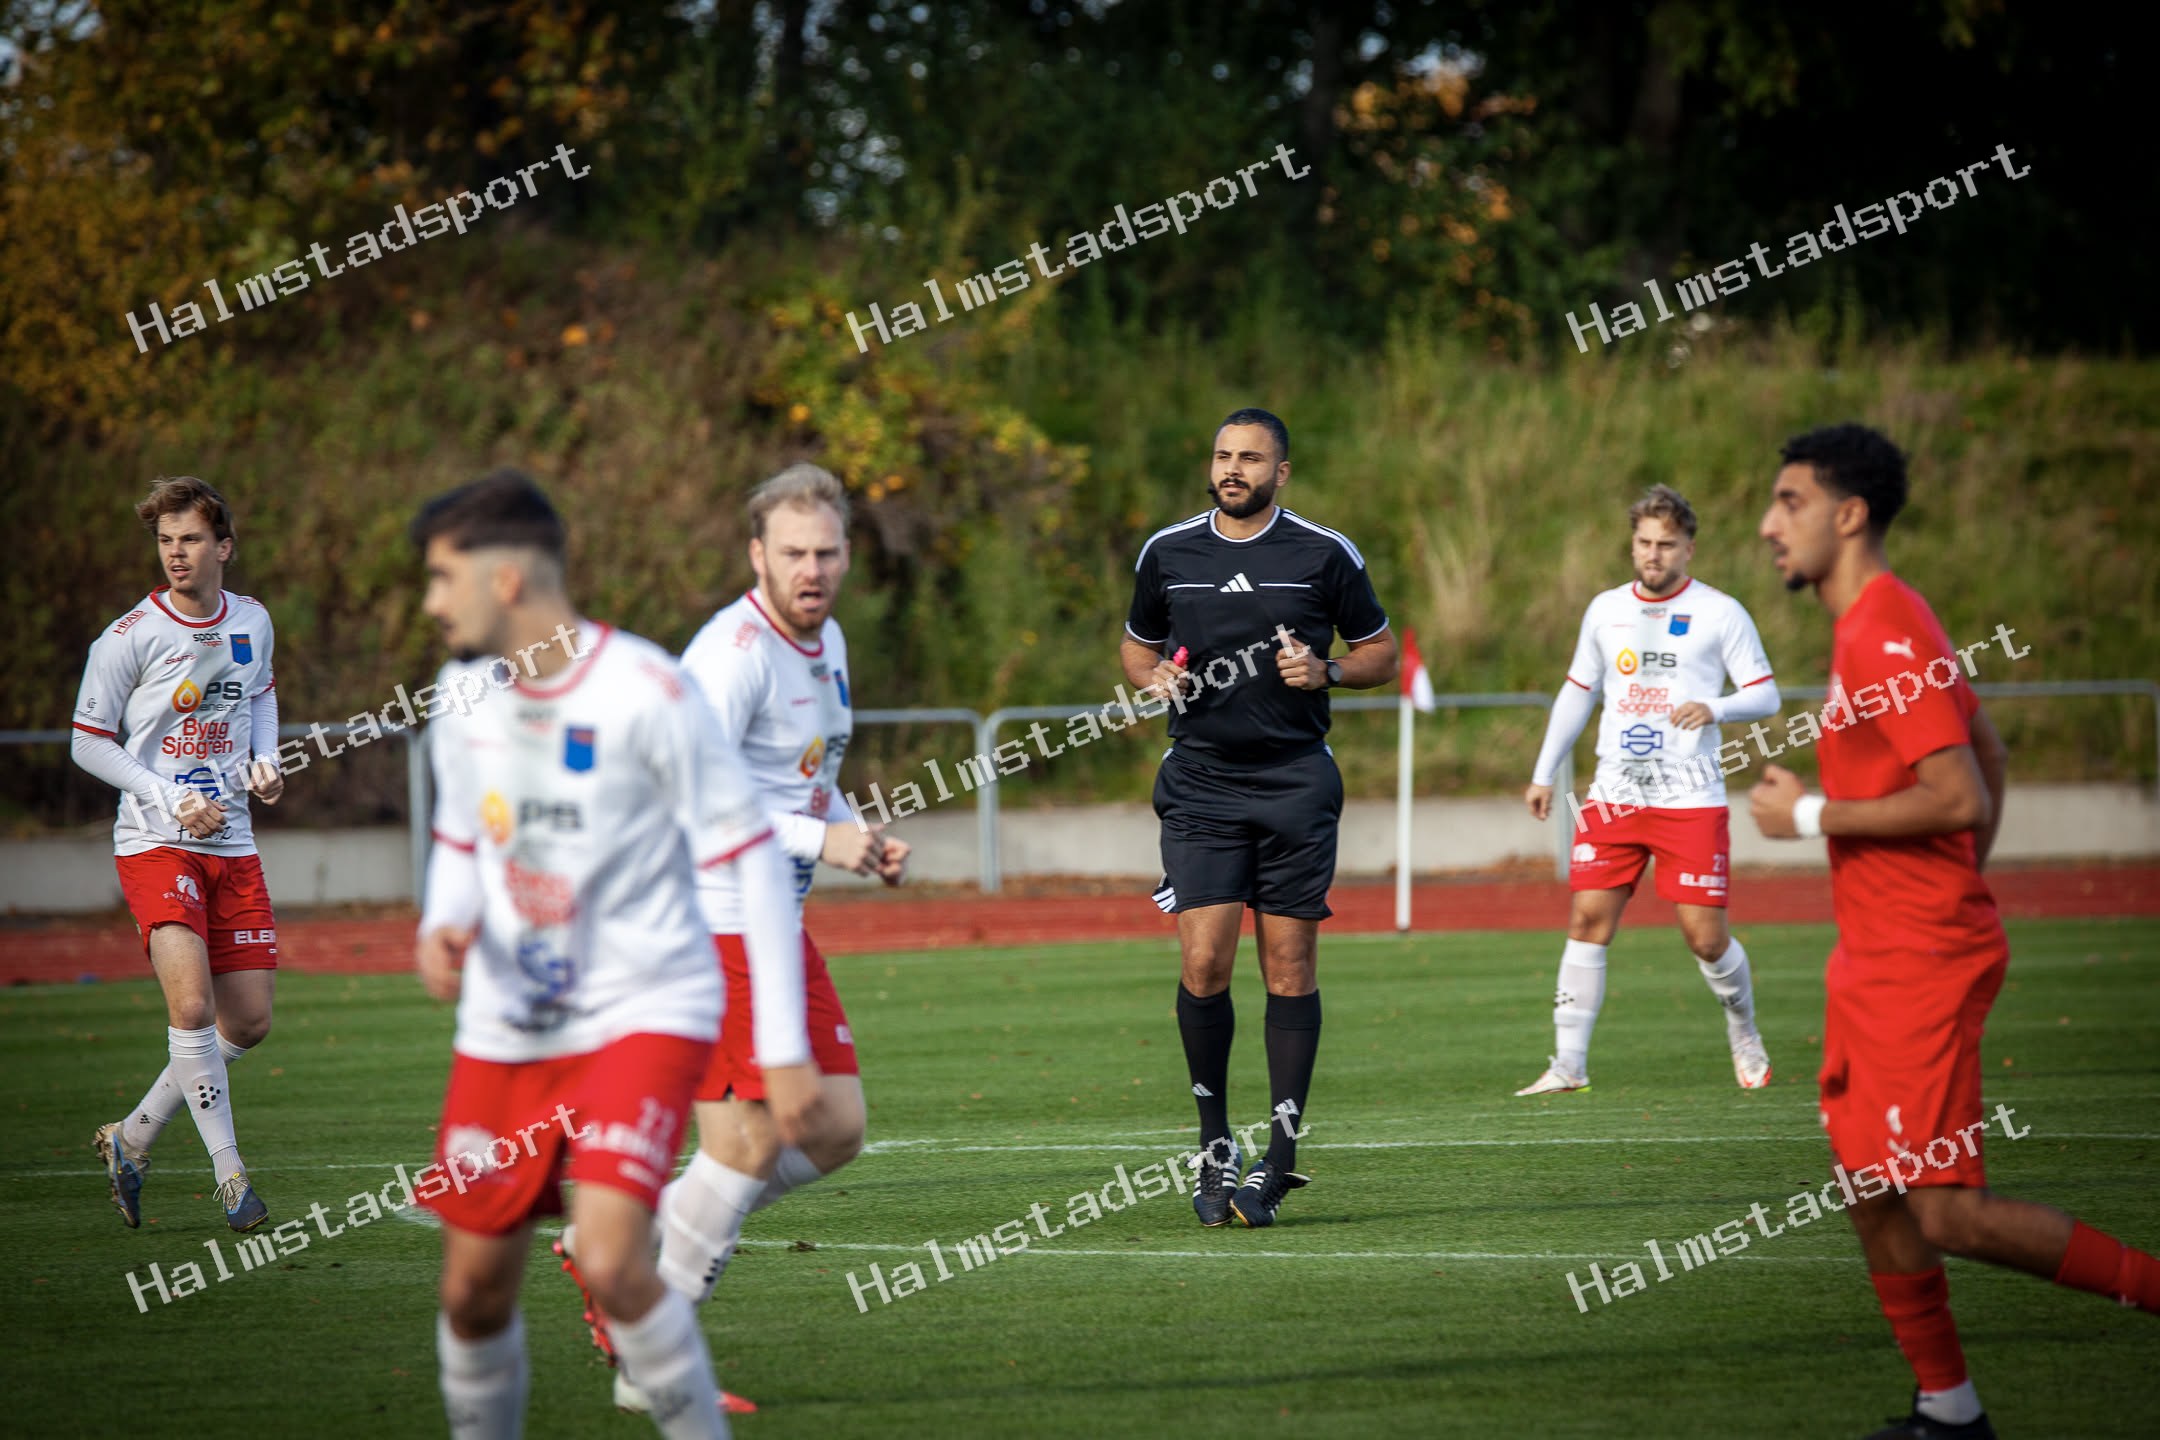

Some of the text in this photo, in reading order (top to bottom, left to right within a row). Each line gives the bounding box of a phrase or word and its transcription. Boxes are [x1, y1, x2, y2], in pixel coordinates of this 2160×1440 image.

[193, 632, 222, 642] sport
[1642, 652, 1677, 667] PS
[204, 682, 242, 700] PS
[183, 717, 230, 740] Bygg
[162, 736, 233, 760] Sjögren
